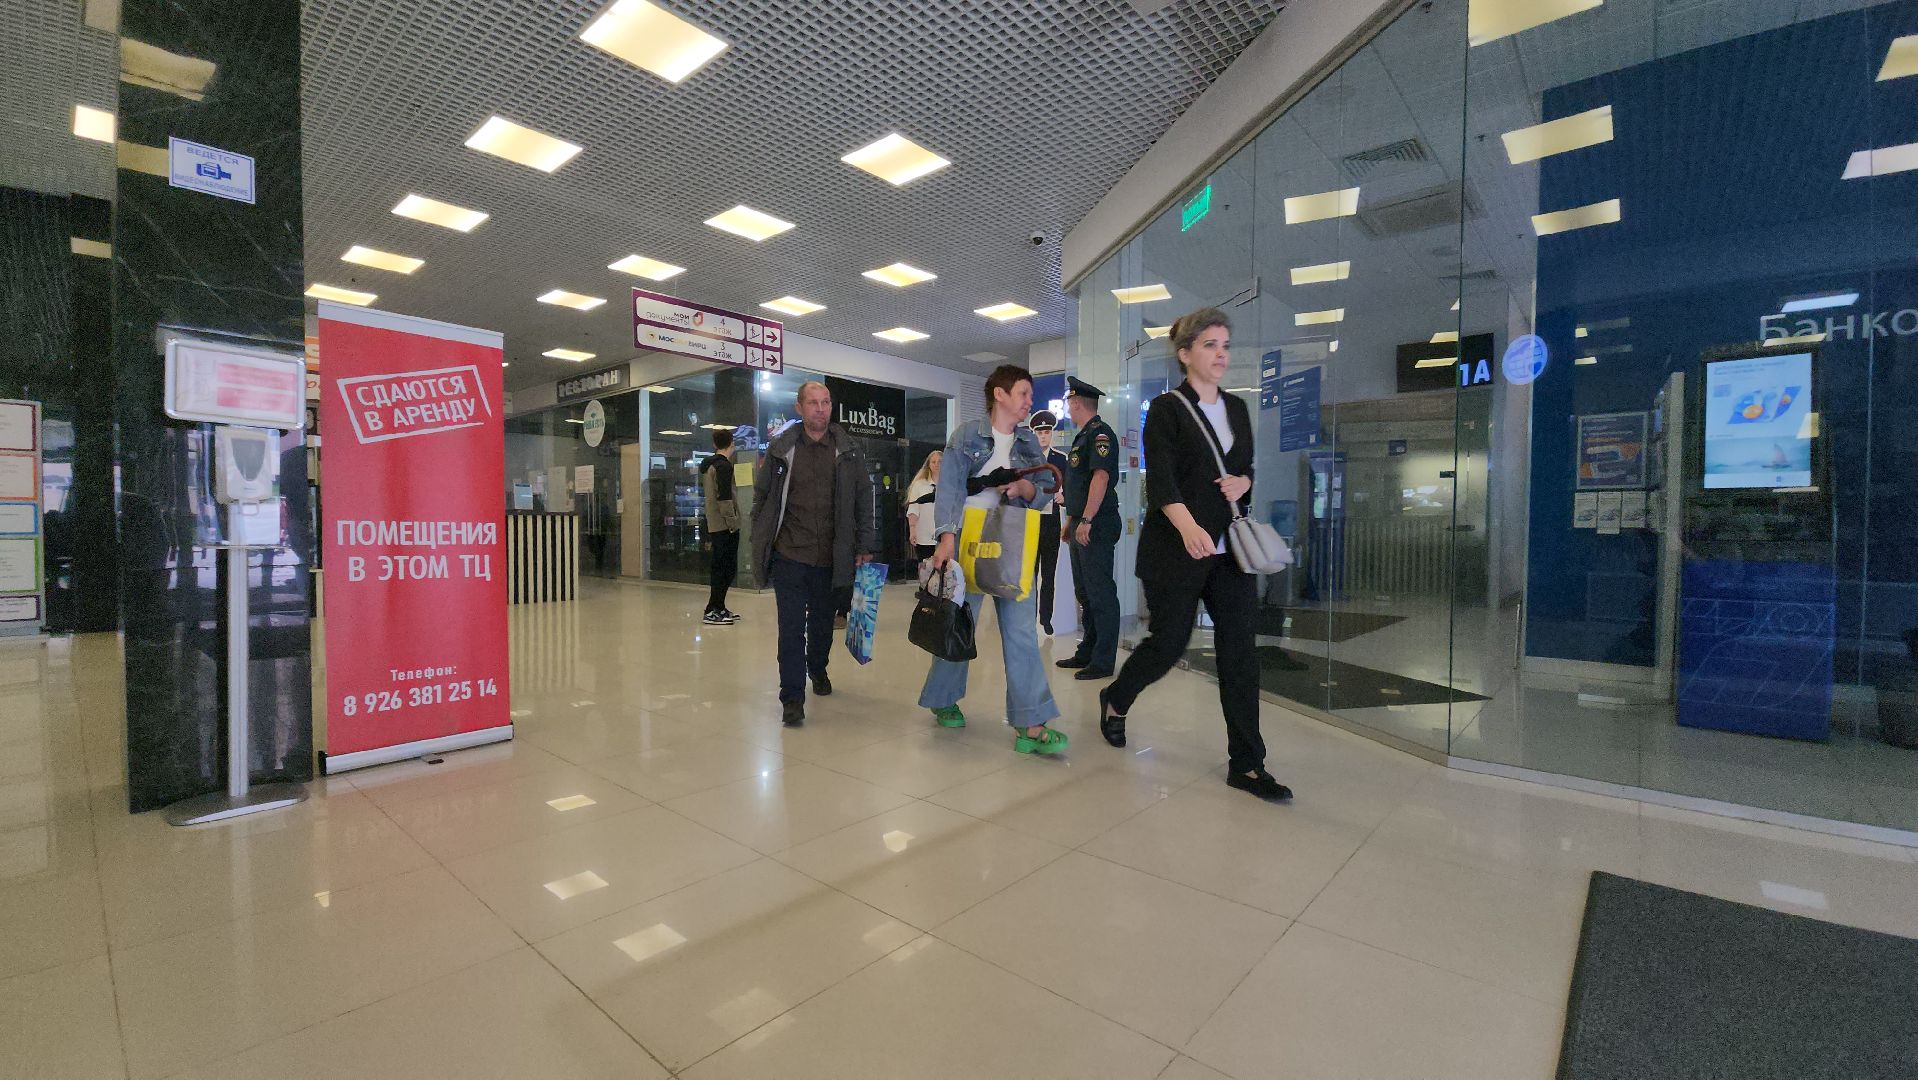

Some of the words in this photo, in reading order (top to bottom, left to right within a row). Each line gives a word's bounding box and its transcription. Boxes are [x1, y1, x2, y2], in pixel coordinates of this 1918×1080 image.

[186, 146, 240, 166] ВЕДЕТСЯ
[1760, 308, 1918, 342] Банко
[713, 350, 733, 360] этаж
[720, 341, 727, 351] 3
[355, 375, 467, 408] СДАЮТСЯ
[364, 410, 384, 431] В
[394, 398, 475, 427] АРЕНДУ
[839, 402, 896, 435] LuxBag
[336, 519, 498, 550] ПОМЕЩЕНИЯ
[348, 556, 366, 582] В
[378, 555, 449, 581] ЭТОМ
[459, 554, 491, 581] ТЦ
[390, 665, 457, 682] Телефон:
[343, 695, 357, 717] 8
[364, 690, 402, 713] 926
[409, 684, 442, 707] 381
[443, 680, 467, 702] 25
[477, 678, 498, 697] 14
